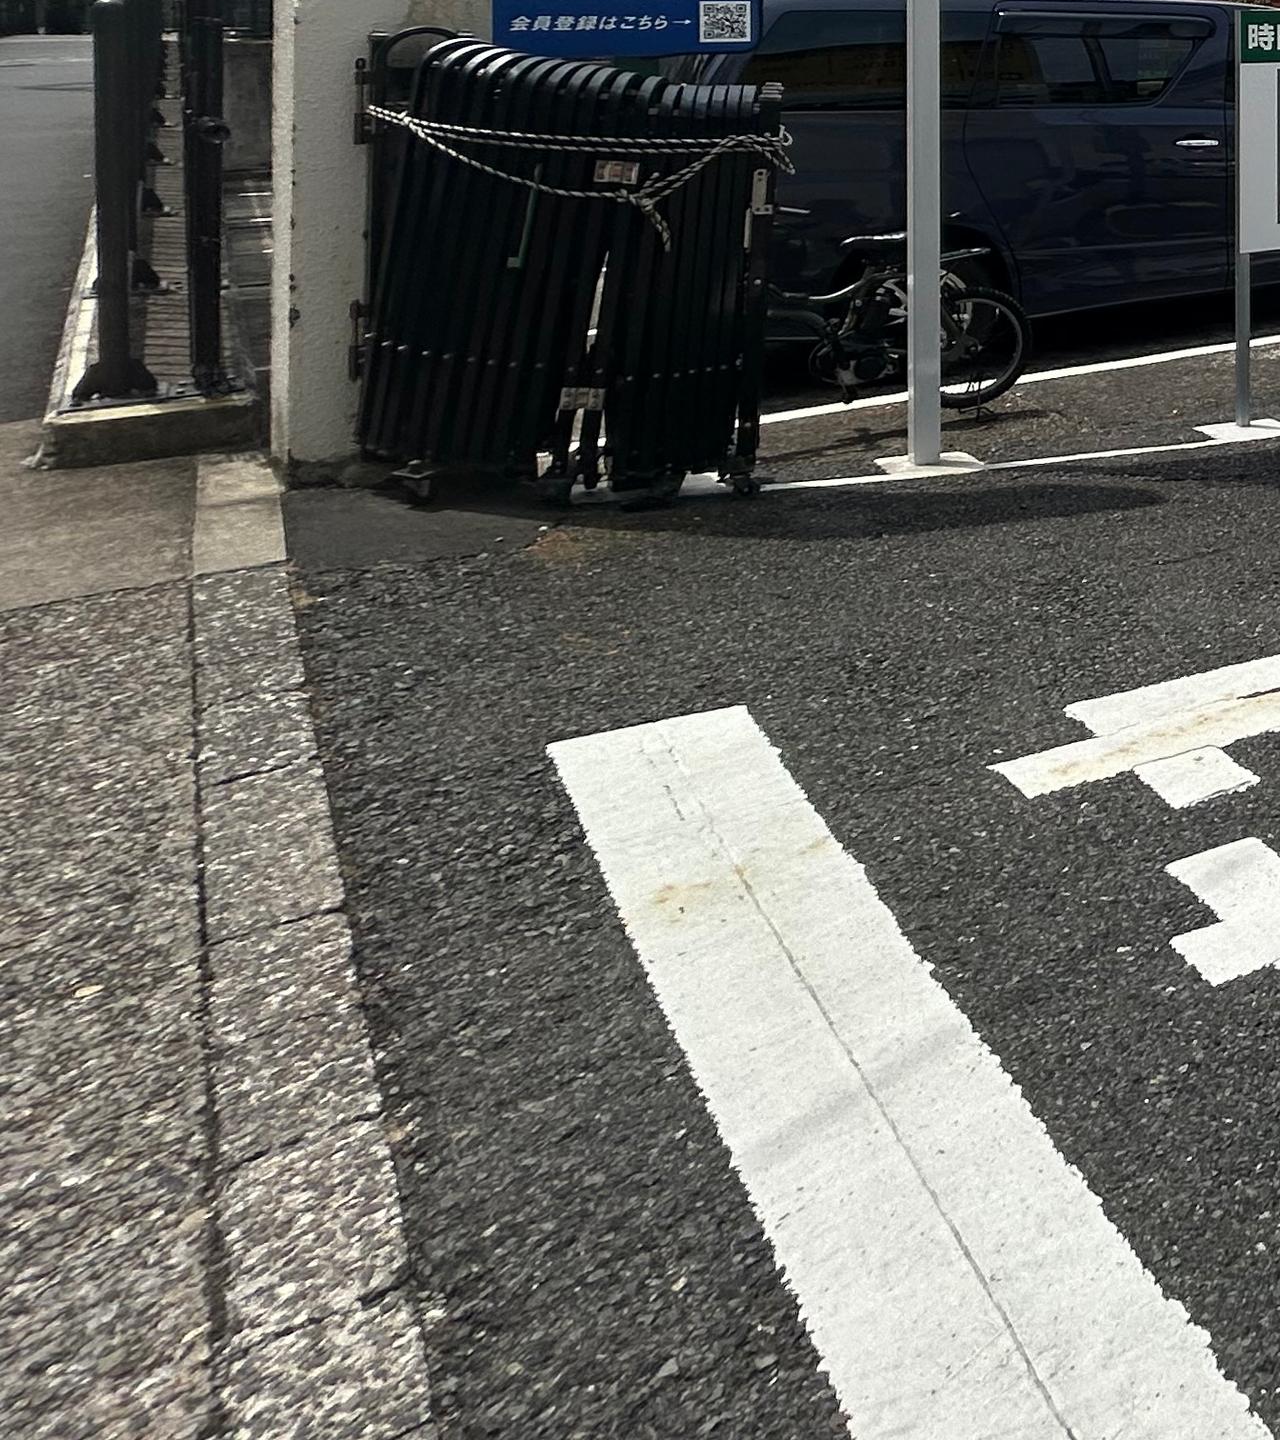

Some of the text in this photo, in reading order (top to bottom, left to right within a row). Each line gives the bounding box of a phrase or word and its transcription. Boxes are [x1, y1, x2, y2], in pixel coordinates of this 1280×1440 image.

[509, 15, 668, 32] 会員登録はこちら
